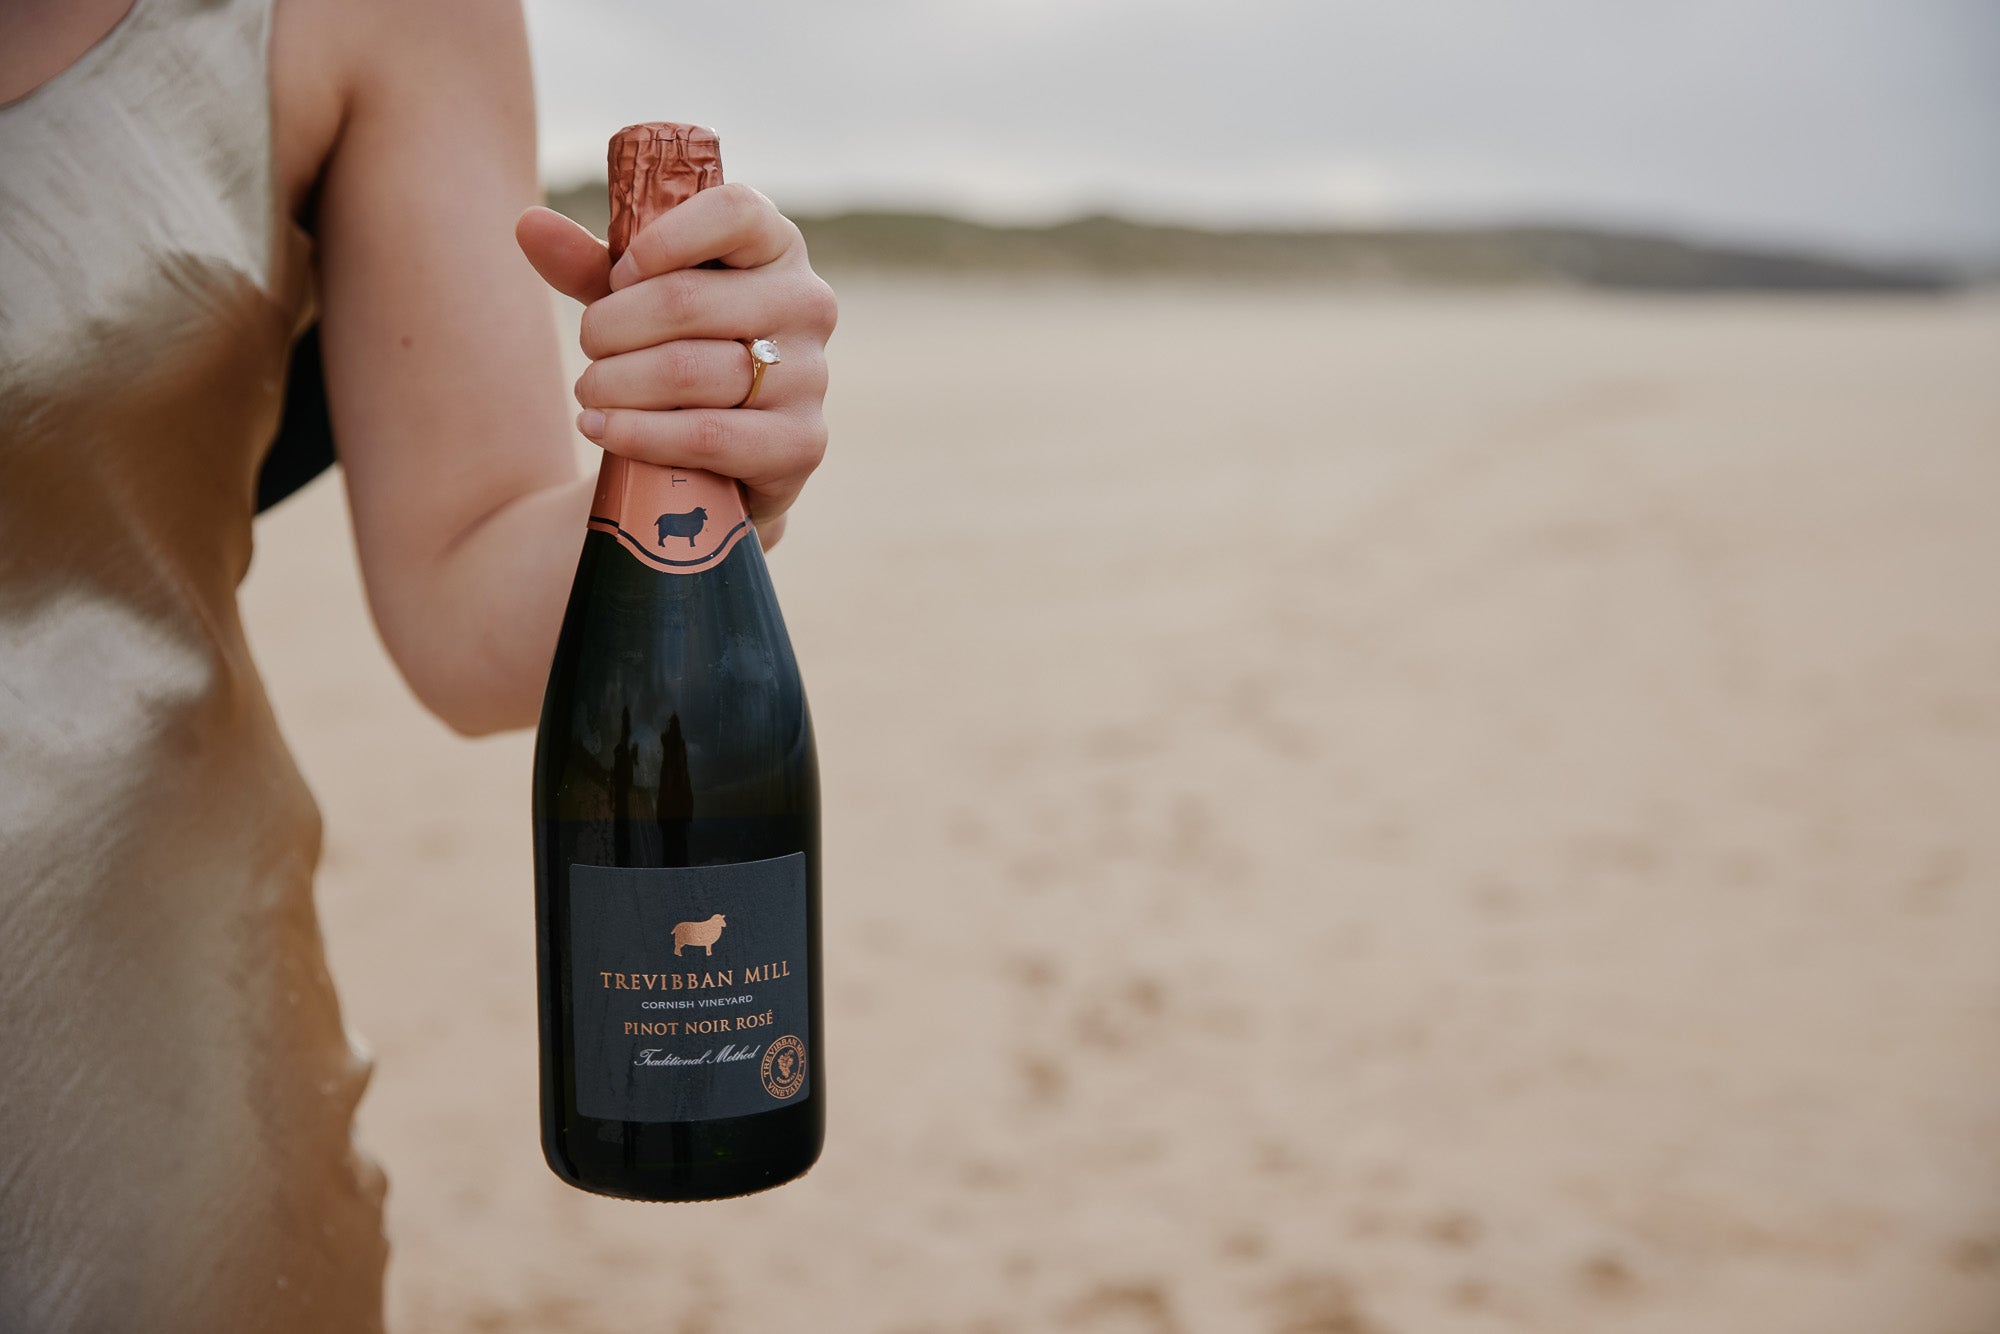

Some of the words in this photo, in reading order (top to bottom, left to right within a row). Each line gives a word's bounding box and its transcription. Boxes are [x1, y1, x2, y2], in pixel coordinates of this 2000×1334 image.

[600, 969, 734, 991] TREVIBBAN
[744, 960, 791, 985] MILL
[641, 1000, 695, 1010] CORNISH
[698, 994, 754, 1009] VINEYARD
[624, 1021, 679, 1036] PINOT
[685, 1019, 732, 1035] NOIR
[736, 1009, 774, 1031] ROSÉ
[633, 1049, 706, 1067] Traditional
[706, 1044, 762, 1065] Method
[763, 1038, 798, 1078] TREVIBBAN
